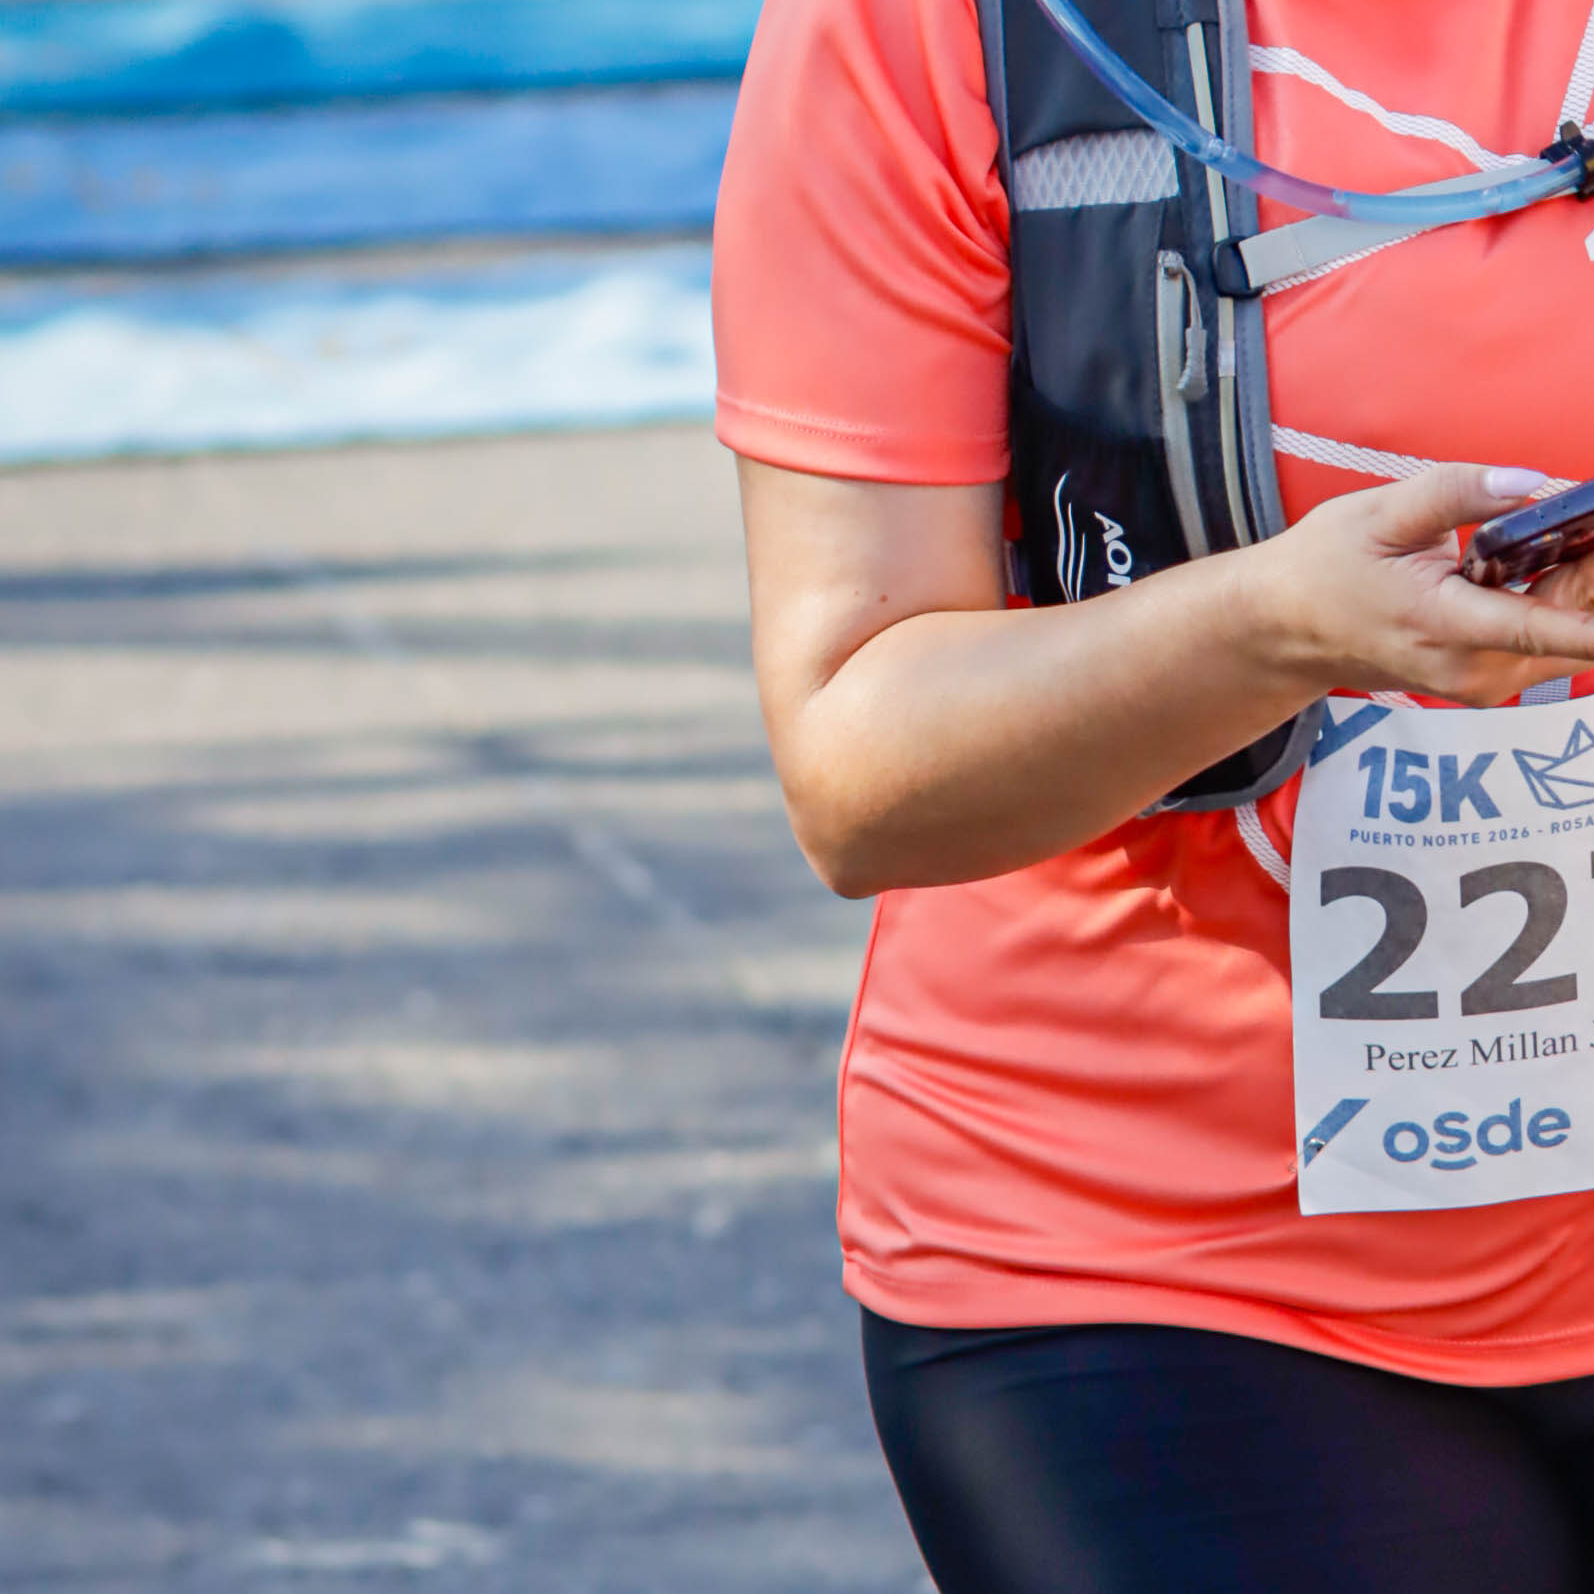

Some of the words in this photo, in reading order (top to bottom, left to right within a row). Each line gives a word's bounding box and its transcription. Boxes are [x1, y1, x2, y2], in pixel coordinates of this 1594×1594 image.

[1358, 745, 1503, 824] 15K
[1349, 828, 1415, 847] PUERTO
[1423, 831, 1481, 848] NORTE
[1488, 826, 1531, 843] 2026
[1364, 1042, 1459, 1072] Perez
[1470, 1031, 1579, 1067] Millan
[1383, 1097, 1572, 1167] osde
